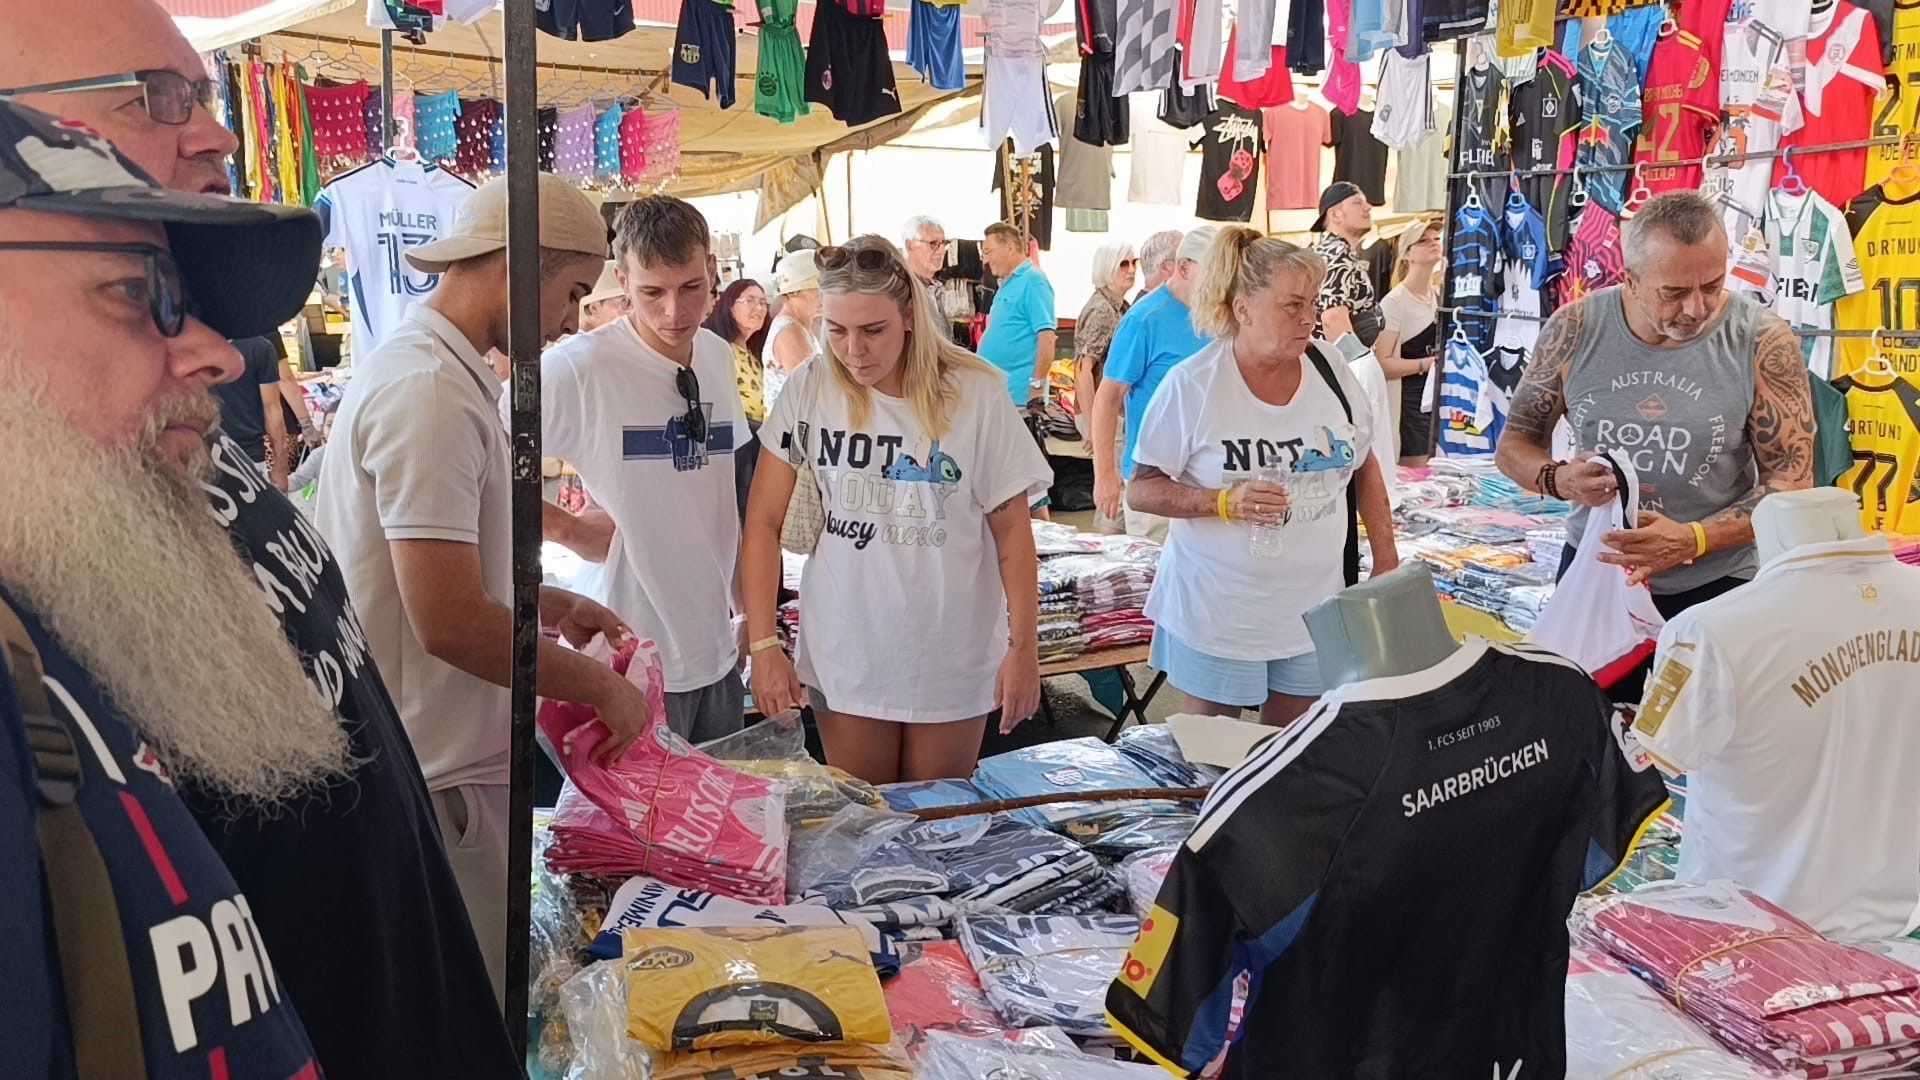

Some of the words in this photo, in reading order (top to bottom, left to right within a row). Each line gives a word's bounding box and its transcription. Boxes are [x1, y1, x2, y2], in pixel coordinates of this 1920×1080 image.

[379, 208, 438, 230] MÜLLER
[1611, 371, 1703, 401] AUSTRALIA
[1597, 419, 1691, 450] ROAD
[1689, 414, 1725, 487] FREEDOM
[817, 428, 903, 479] NOT
[1222, 437, 1304, 473] NOT
[1594, 443, 1688, 476] SGN
[818, 469, 959, 519] TODAY
[827, 511, 877, 550] busy
[882, 521, 947, 547] mode
[1437, 732, 1456, 748] FCS
[1456, 724, 1476, 742] SEIT
[1477, 715, 1502, 734] 1903
[1401, 738, 1549, 818] SAARBRÜCKEN
